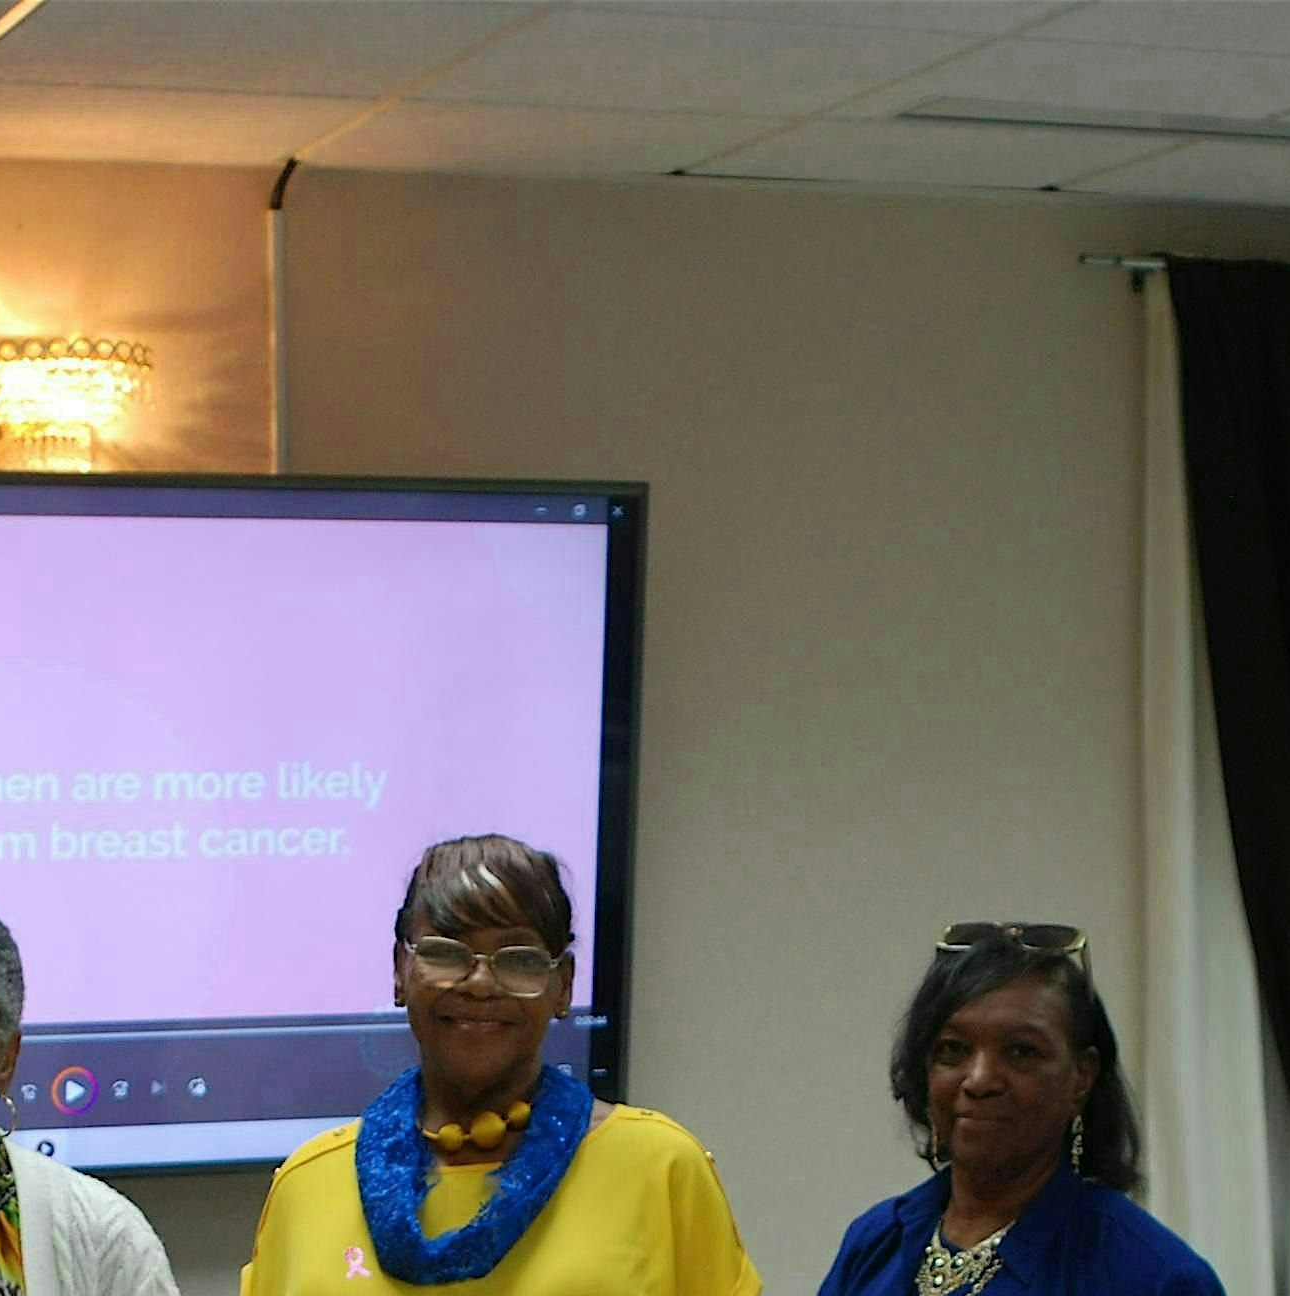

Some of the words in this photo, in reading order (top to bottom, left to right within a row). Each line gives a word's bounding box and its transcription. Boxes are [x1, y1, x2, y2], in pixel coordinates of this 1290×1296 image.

[72, 769, 142, 802] are
[153, 769, 266, 801] more
[277, 761, 388, 809] likely
[49, 821, 188, 862] breast
[198, 826, 353, 858] cancer.
